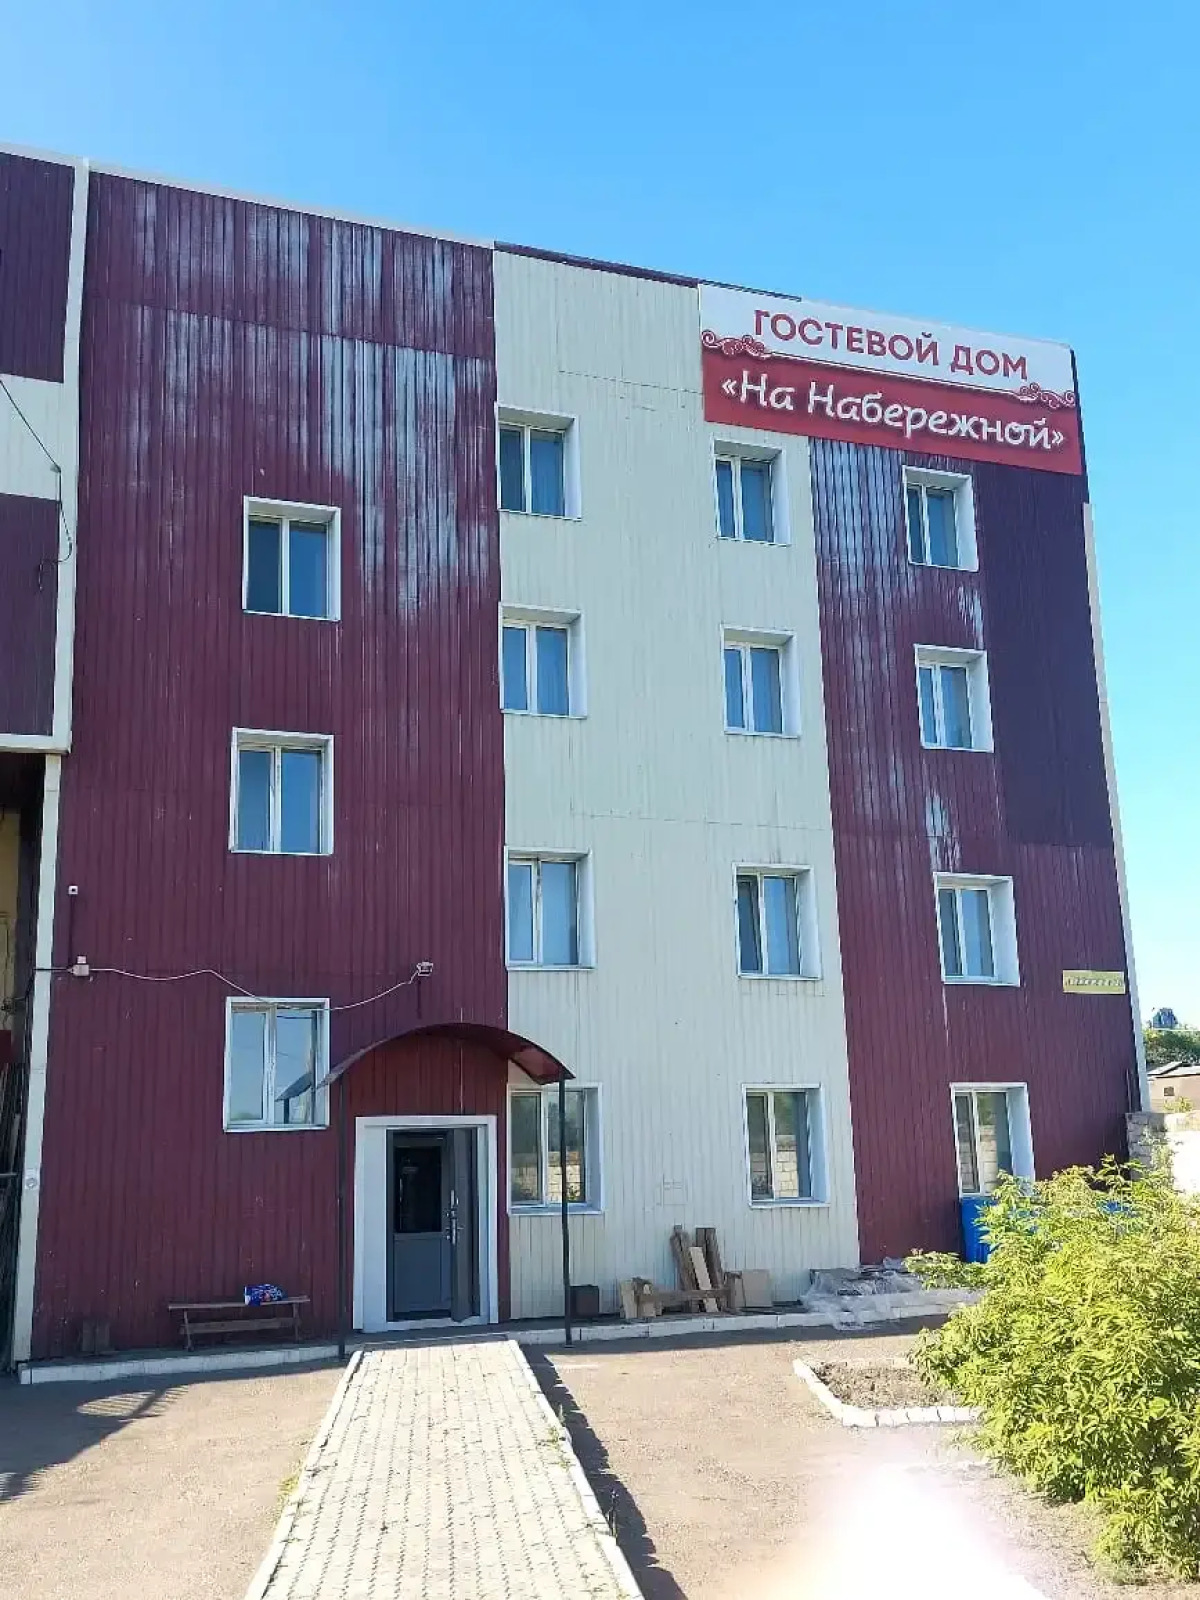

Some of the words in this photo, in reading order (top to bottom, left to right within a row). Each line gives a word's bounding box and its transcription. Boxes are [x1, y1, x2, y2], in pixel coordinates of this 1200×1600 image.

[754, 309, 939, 366] ГОСТЕВОЙ
[951, 345, 1028, 380] ДОМ
[721, 370, 795, 409] «На
[807, 381, 1064, 449] Набережной»
